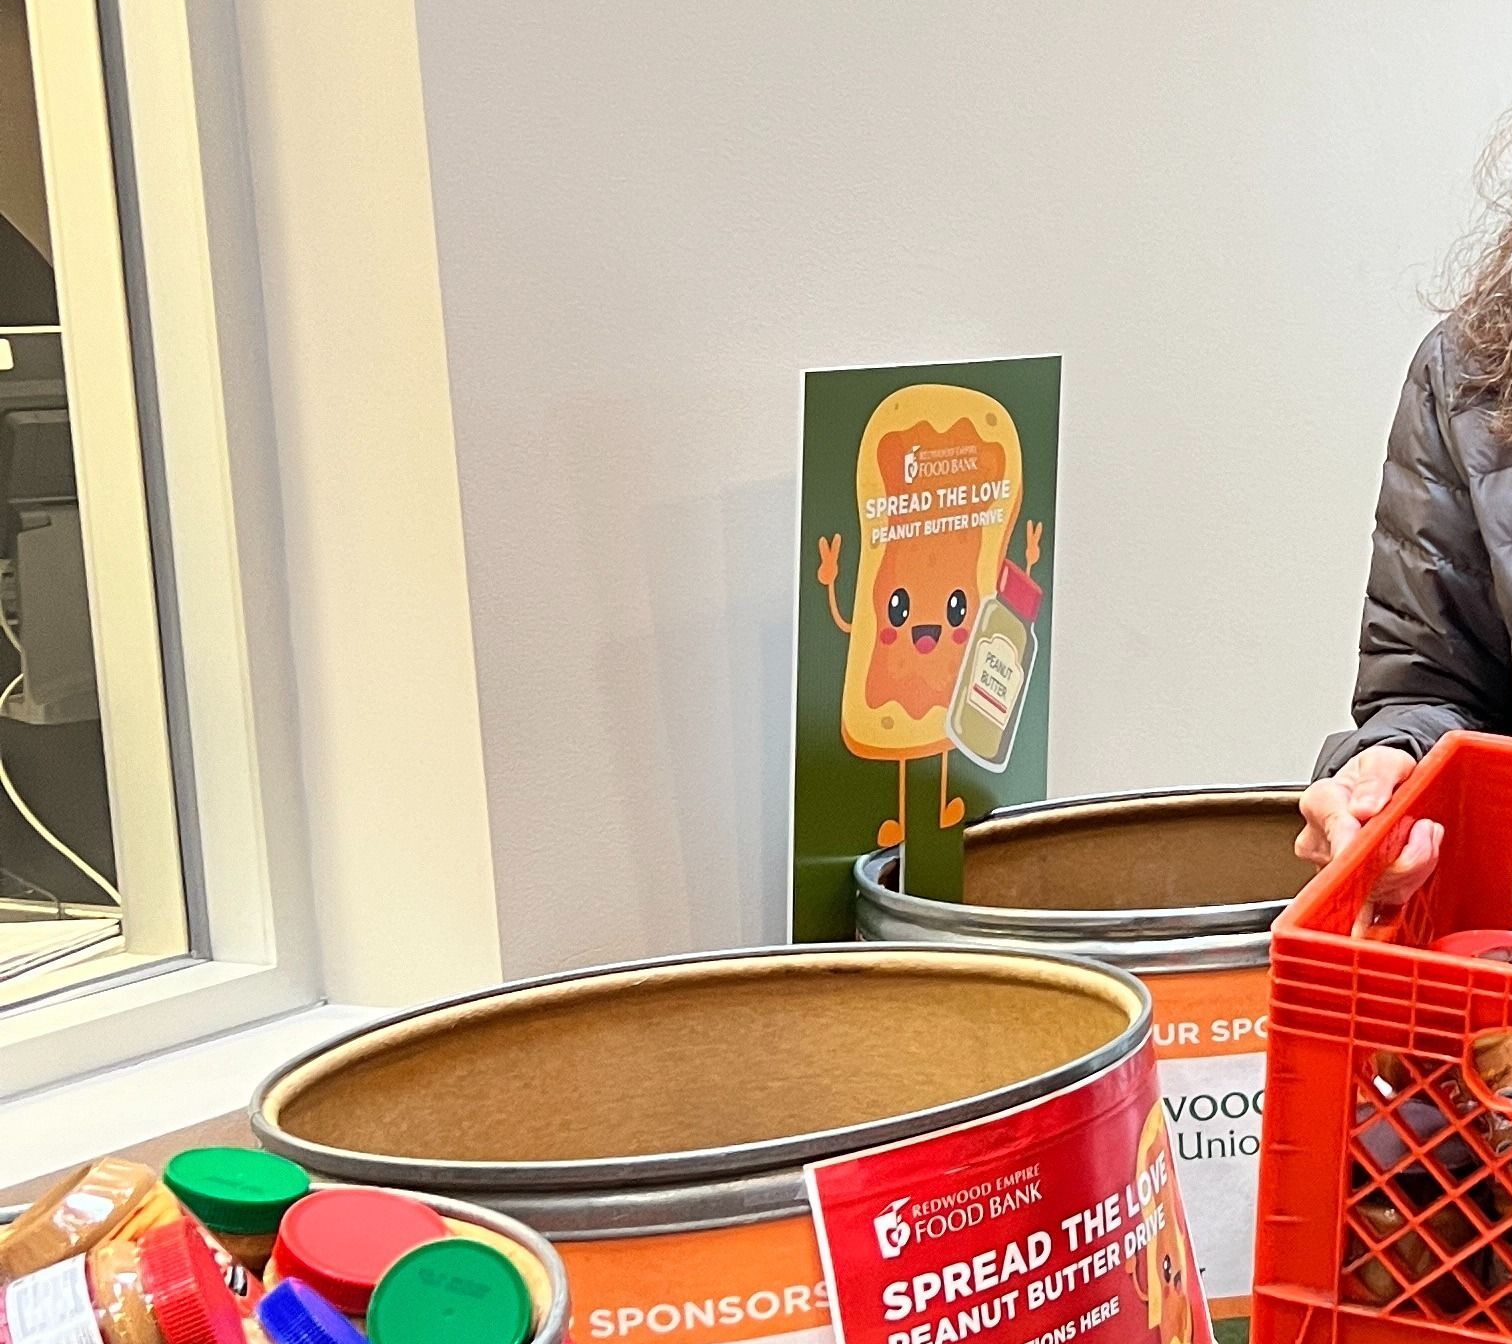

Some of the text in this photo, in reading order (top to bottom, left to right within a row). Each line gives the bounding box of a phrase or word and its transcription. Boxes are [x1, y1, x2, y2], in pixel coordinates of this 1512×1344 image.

[918, 457, 978, 478] FOOD BANK
[865, 479, 1011, 520] SPREAD THE LOVE
[871, 508, 1004, 544] PEANUT BUTTER DRIVE
[1153, 1021, 1200, 1047] UR
[1177, 1130, 1260, 1161] Unio
[912, 1163, 1040, 1218] REDWOOD EMPIRE
[914, 1180, 1043, 1244] FOOD BANK
[882, 1153, 1168, 1320] SPREAD THE LOVE
[1026, 1247, 1121, 1311] BUTTER
[1124, 1205, 1166, 1259] DRIVE
[1080, 1296, 1120, 1331] HERE
